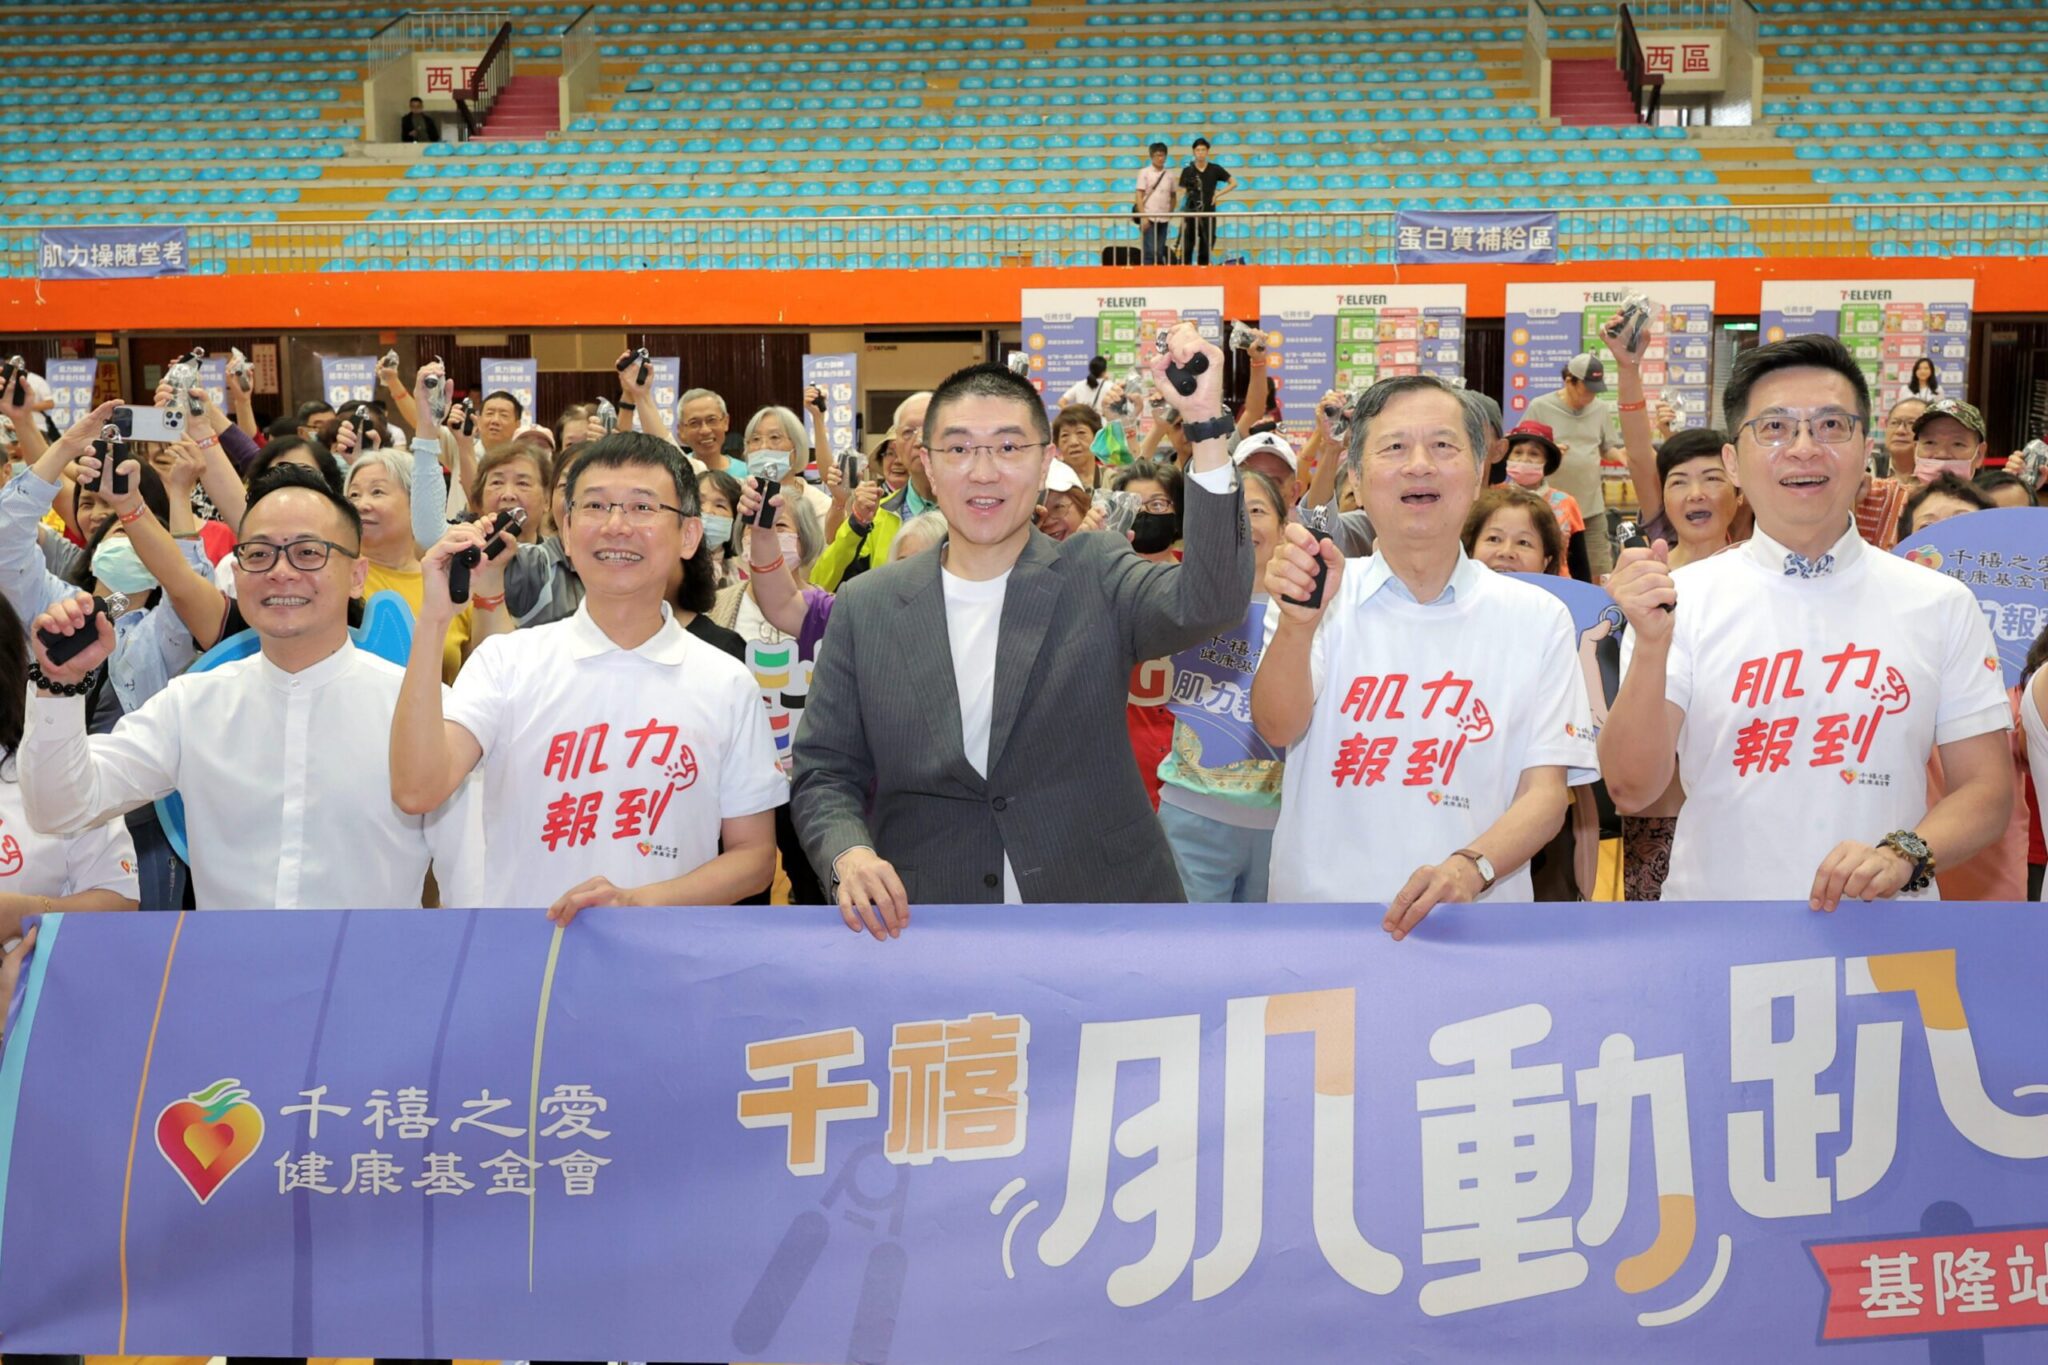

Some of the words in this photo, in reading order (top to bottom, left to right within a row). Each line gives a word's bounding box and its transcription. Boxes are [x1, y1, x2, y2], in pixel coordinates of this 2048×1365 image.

[1646, 44, 1710, 73] 西區
[43, 240, 184, 268] 肌力操隨堂考
[1398, 225, 1553, 251] 蛋白質補給區
[1340, 670, 1474, 724] 肌力
[1731, 642, 1881, 709] 肌力
[543, 717, 681, 783] 肌力
[1331, 732, 1468, 789] 報到
[1732, 705, 1885, 778] 報到
[540, 781, 676, 853] 報到
[279, 1083, 612, 1141] 千禧之愛
[737, 1012, 1030, 1177] 千禧
[1037, 948, 2048, 1317] 肌動趴
[273, 1148, 612, 1197] 健康基金會
[1858, 1243, 2048, 1320] 基隆站
